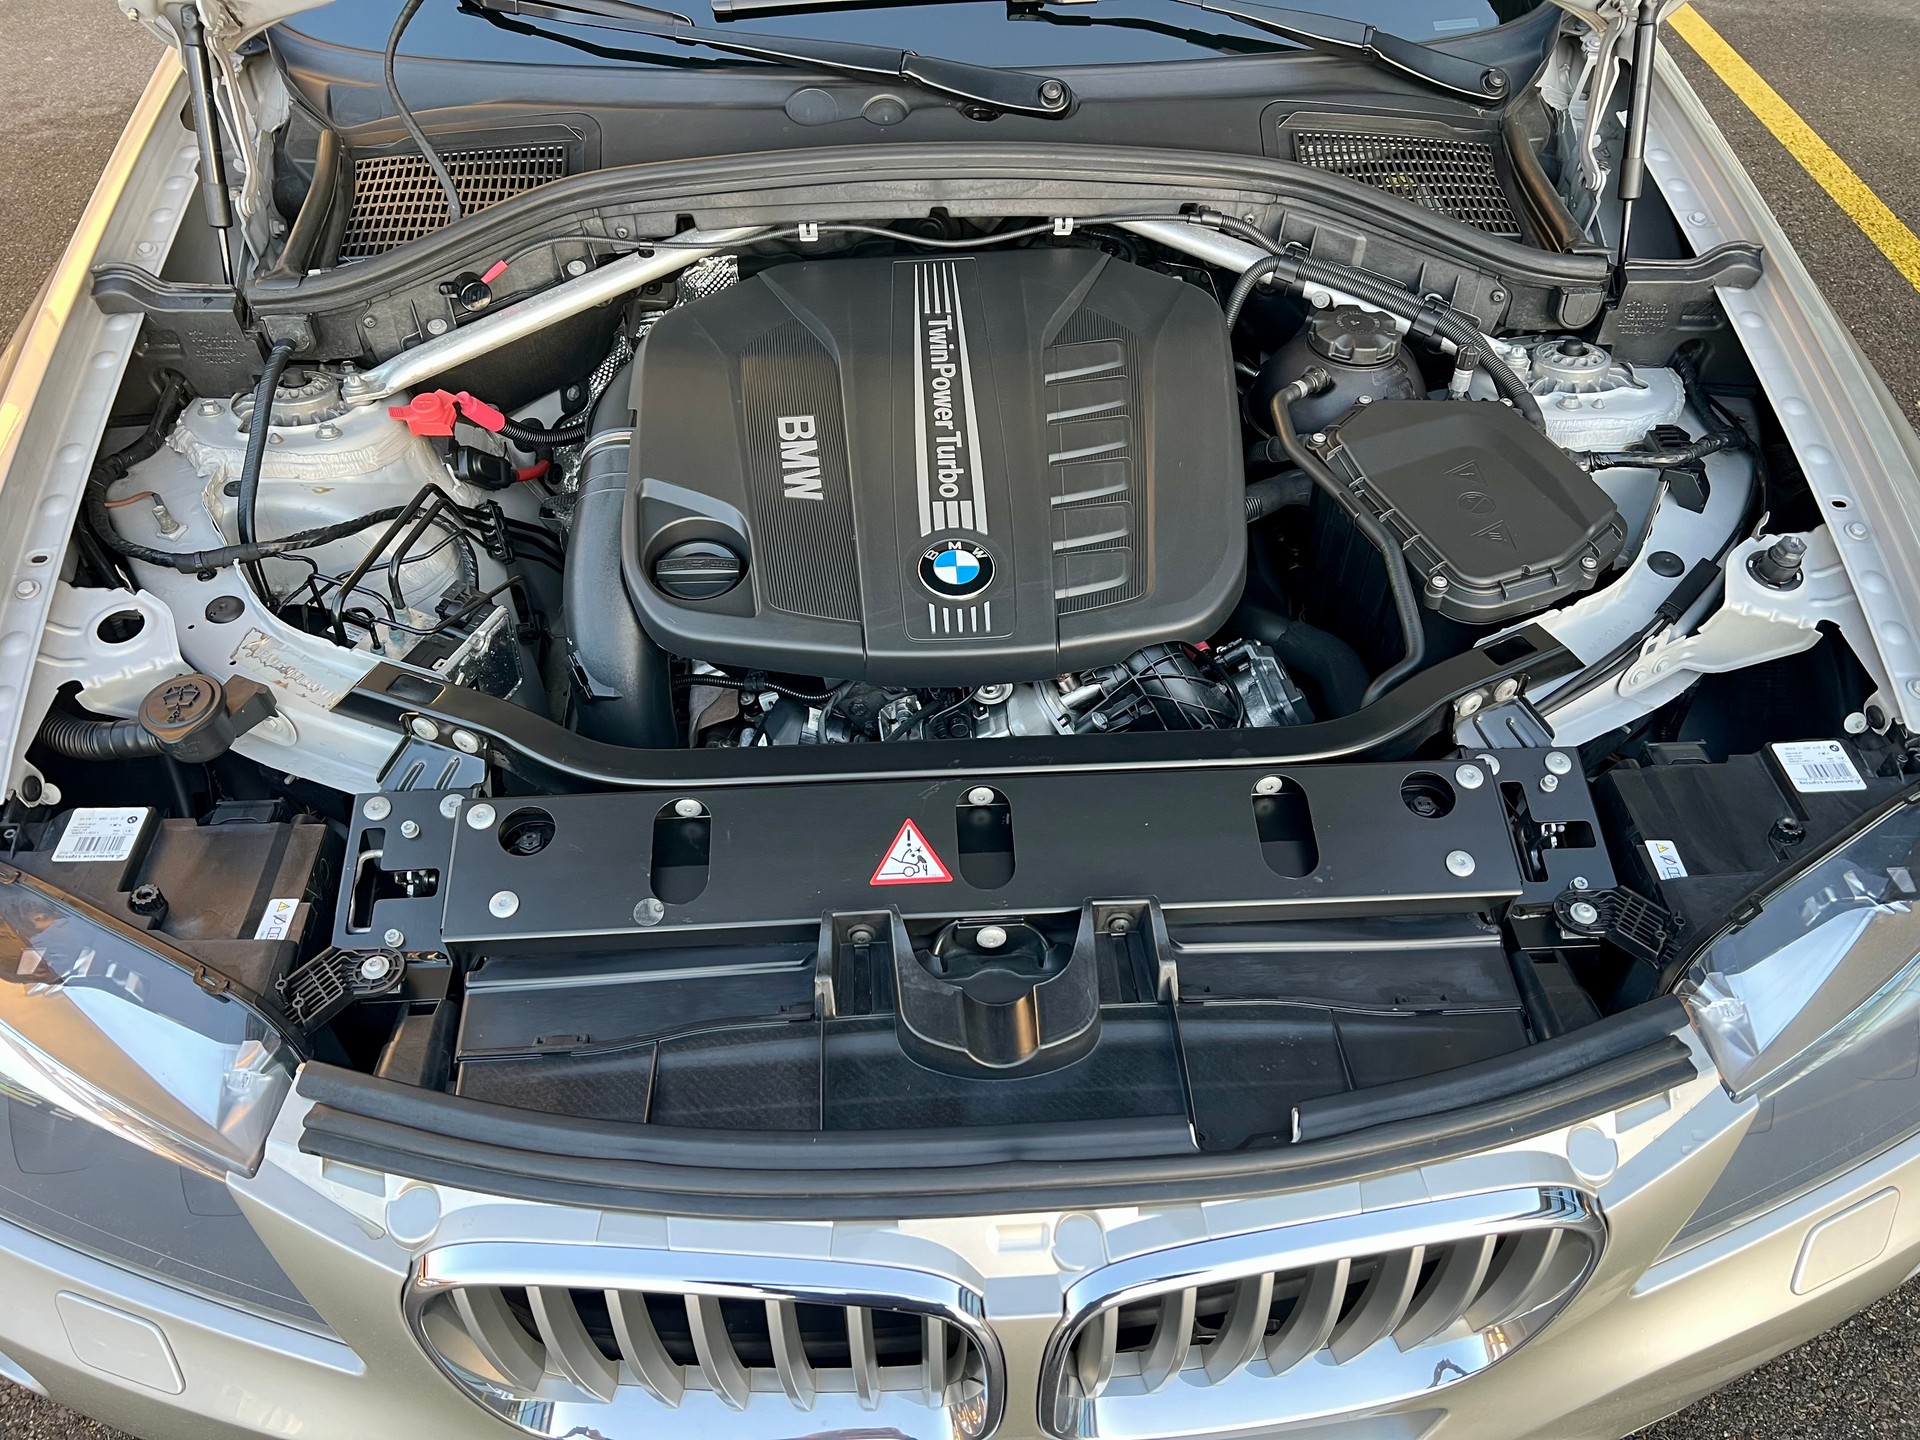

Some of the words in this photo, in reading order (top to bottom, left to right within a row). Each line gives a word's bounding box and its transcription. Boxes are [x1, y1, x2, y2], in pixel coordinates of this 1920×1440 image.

[927, 314, 956, 430] TwinPower
[777, 415, 824, 500] BMW
[935, 431, 964, 498] Turbo
[924, 541, 988, 561] BMW
